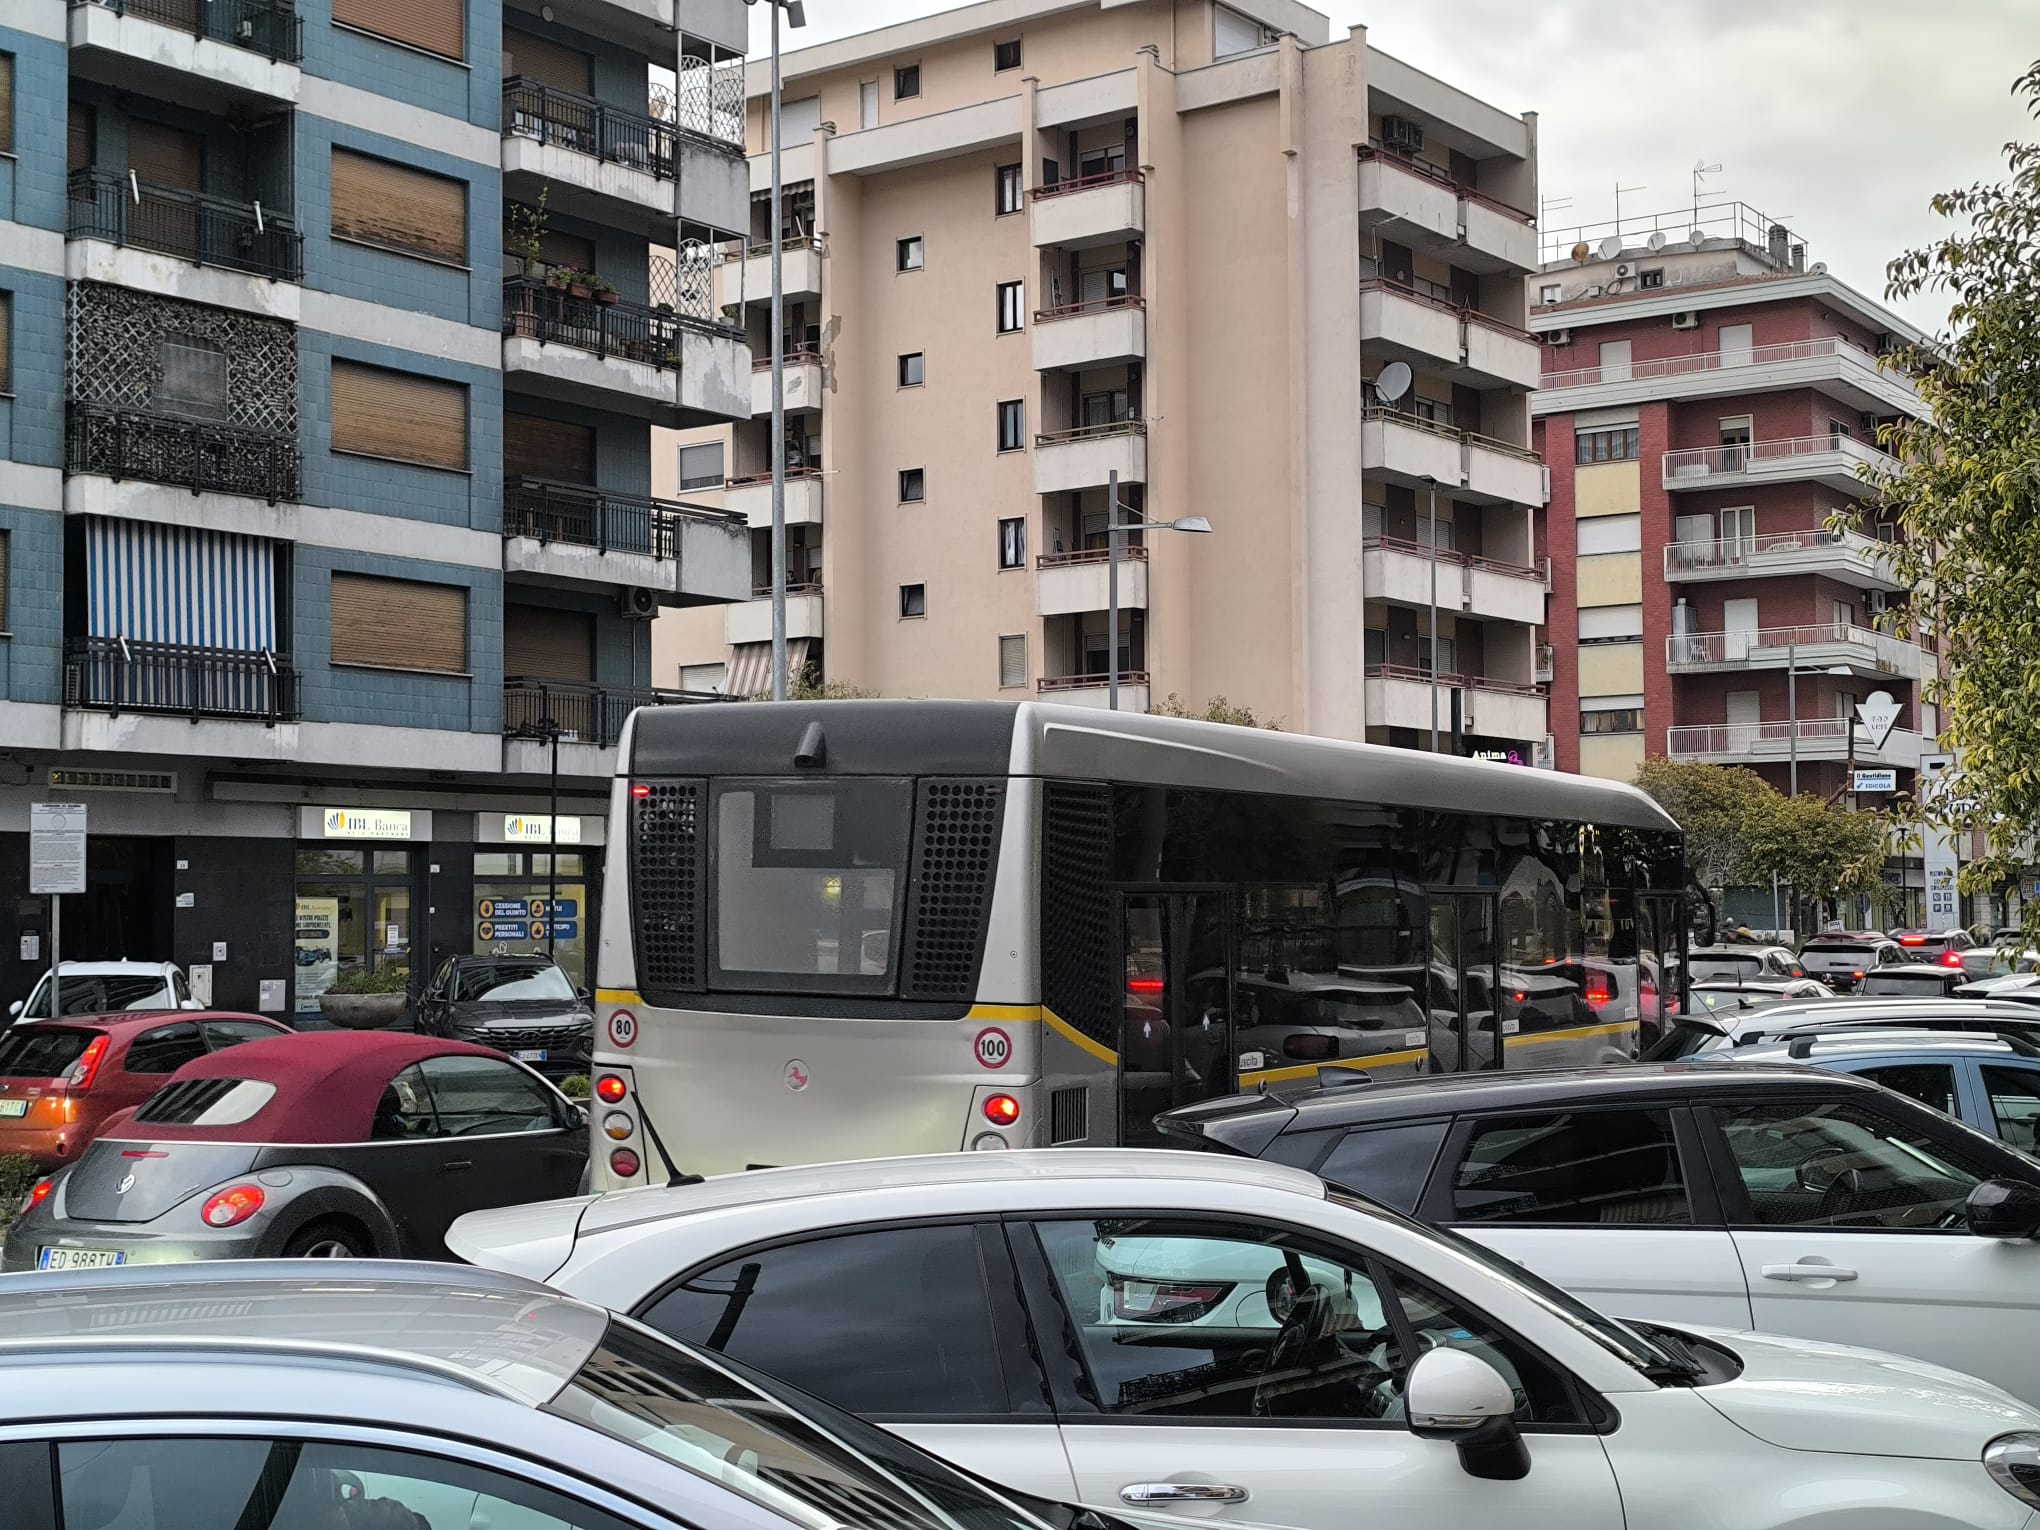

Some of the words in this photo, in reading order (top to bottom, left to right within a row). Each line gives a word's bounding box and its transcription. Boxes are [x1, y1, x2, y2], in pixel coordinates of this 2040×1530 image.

[375, 818, 408, 832] Banca
[615, 1019, 631, 1035] 80
[980, 1039, 1006, 1057] 100
[49, 1250, 67, 1269] ED
